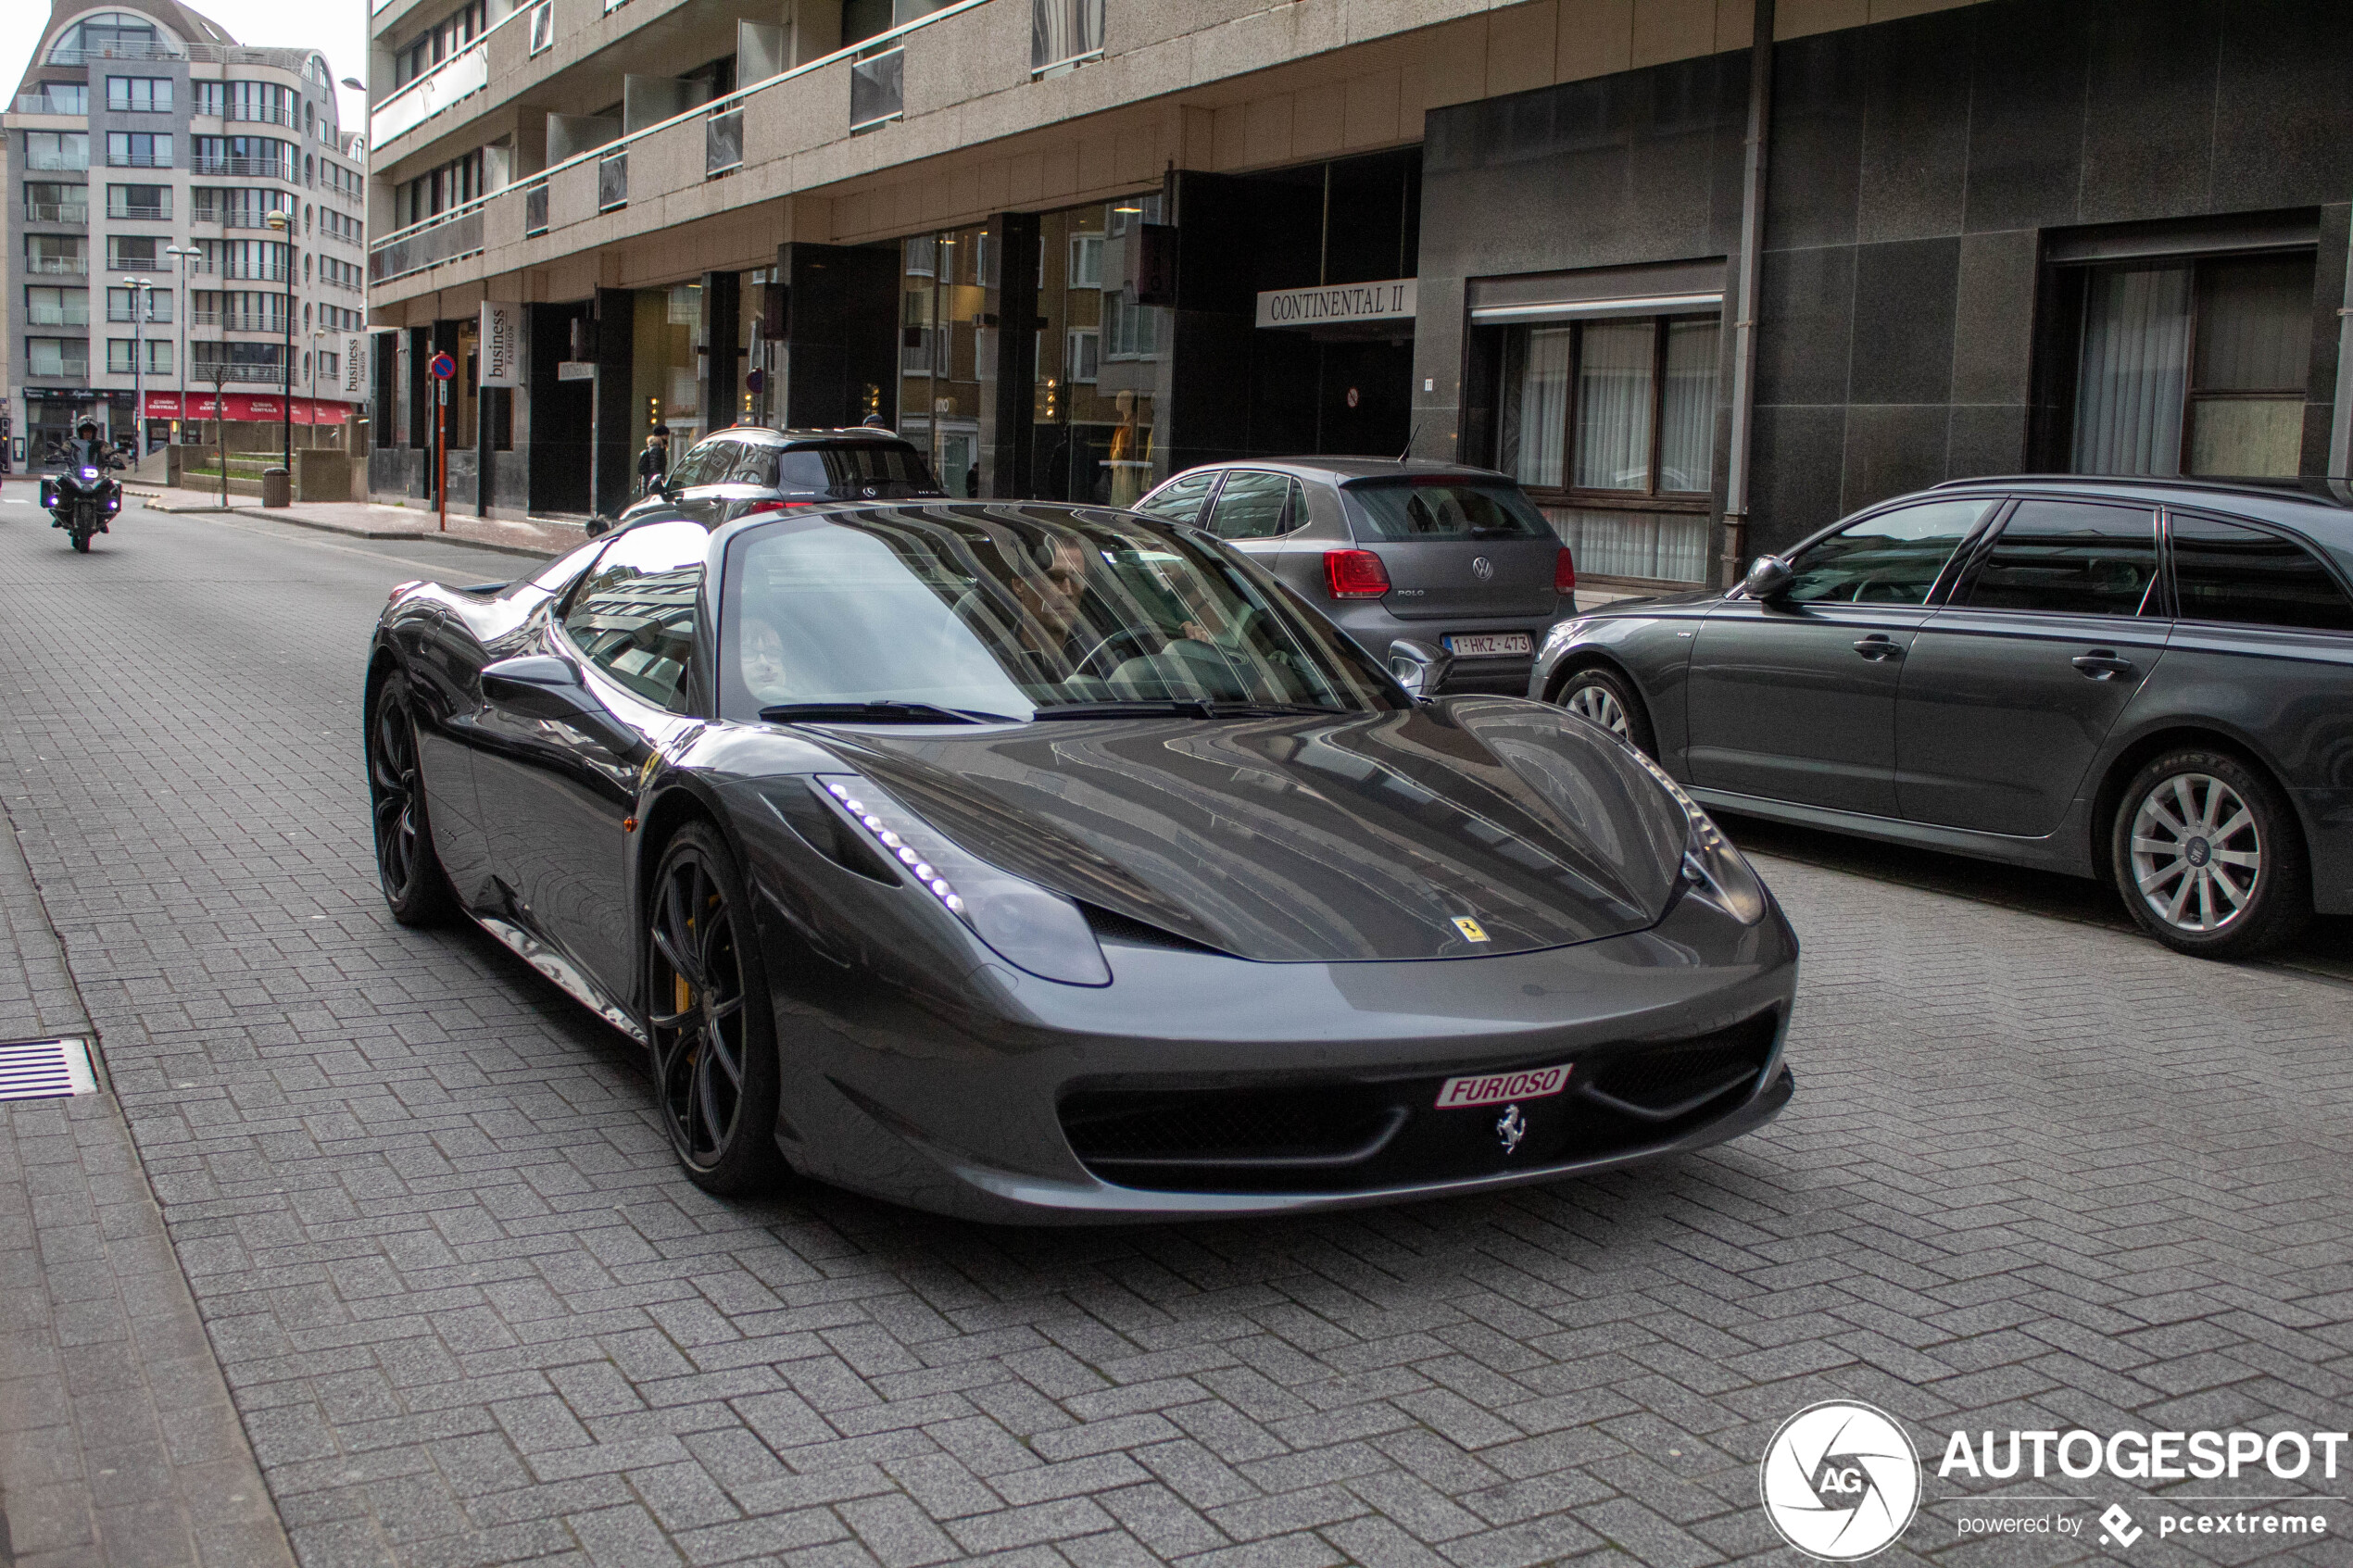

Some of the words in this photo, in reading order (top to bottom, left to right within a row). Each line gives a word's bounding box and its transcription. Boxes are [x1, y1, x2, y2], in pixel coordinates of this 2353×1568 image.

[1271, 287, 1384, 320] CONTINENTAL
[1390, 285, 1403, 312] II
[346, 339, 359, 393] business
[488, 309, 505, 379] business
[1449, 1069, 1561, 1102] FURIOSO
